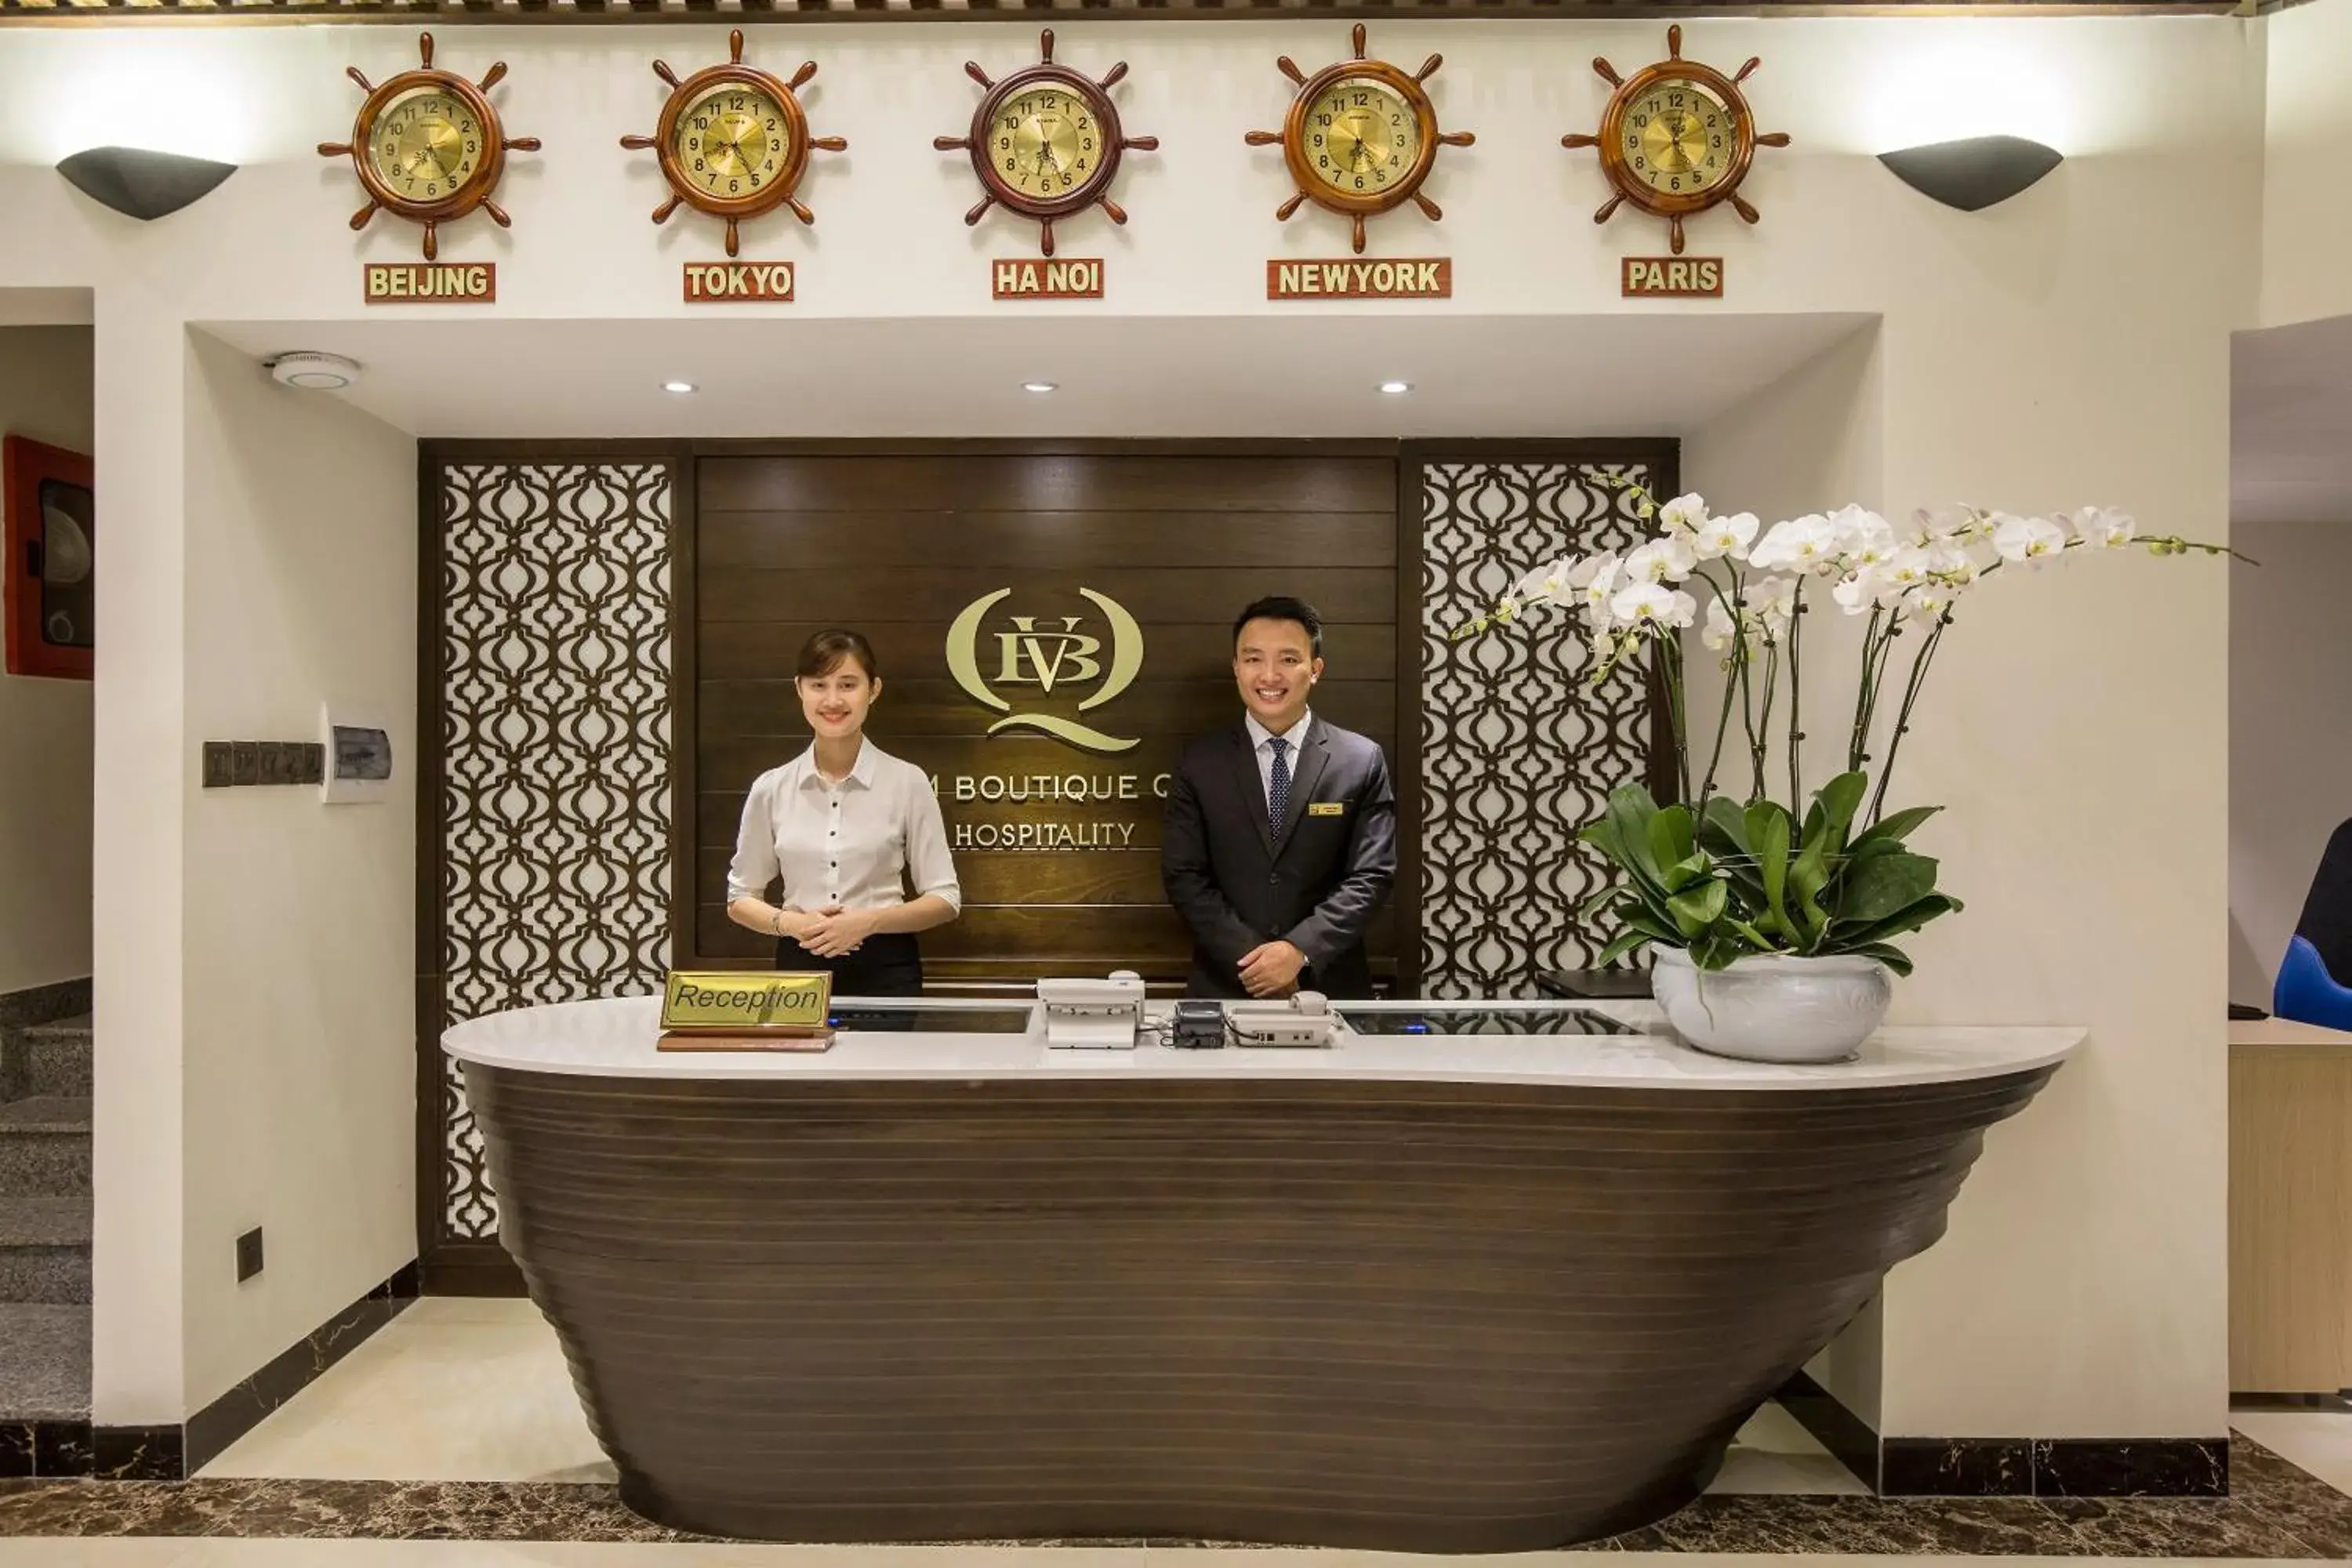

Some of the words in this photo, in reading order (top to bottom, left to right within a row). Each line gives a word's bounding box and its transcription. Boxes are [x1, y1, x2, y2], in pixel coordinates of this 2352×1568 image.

[729, 99, 744, 111] 12
[1039, 97, 1054, 109] 12
[1333, 100, 1345, 111] 11
[1352, 94, 1367, 106] 12
[1377, 99, 1382, 111] 1
[1668, 94, 1683, 107] 12
[1693, 100, 1699, 111] 1
[423, 101, 437, 114] 12
[448, 107, 452, 118] 1
[710, 103, 720, 115] 11
[753, 104, 758, 114] 1
[1019, 102, 1032, 114] 11
[1065, 103, 1069, 114] 1
[1648, 101, 1661, 113] 11
[404, 108, 415, 119] 11
[694, 118, 707, 129] 10
[767, 119, 775, 131] 2
[1004, 118, 1018, 129] 10
[1079, 118, 1087, 129] 2
[1317, 114, 1331, 126] 10
[1392, 114, 1400, 126] 2
[1633, 115, 1646, 127] 10
[1707, 115, 1715, 127] 2
[389, 123, 402, 135] 10
[462, 121, 470, 132] 2
[467, 140, 475, 153] 3
[689, 138, 698, 150] 9
[771, 139, 779, 151] 3
[1001, 138, 1009, 150] 9
[1083, 138, 1091, 151] 3
[1314, 134, 1322, 147] 9
[1396, 134, 1405, 147] 3
[1629, 136, 1638, 147] 9
[1712, 136, 1721, 147] 3
[387, 143, 394, 156] 9
[461, 161, 469, 172] 4
[695, 159, 703, 171] 8
[765, 159, 773, 172] 4
[1007, 158, 1014, 170] 8
[1076, 158, 1085, 170] 4
[1319, 155, 1328, 167] 8
[1390, 155, 1399, 166] 4
[1635, 157, 1643, 169] 8
[1706, 157, 1715, 168] 4
[392, 165, 401, 176] 8
[448, 177, 457, 188] 5
[709, 174, 717, 185] 7
[751, 174, 759, 186] 5
[1021, 173, 1029, 185] 7
[1064, 173, 1072, 185] 5
[1334, 171, 1342, 183] 7
[1355, 176, 1363, 188] 6
[1377, 171, 1385, 183] 5
[1650, 172, 1658, 183] 7
[1693, 171, 1701, 183] 5
[406, 179, 414, 190] 7
[427, 183, 436, 195] 6
[729, 180, 738, 192] 6
[1042, 179, 1050, 191] 6
[1671, 177, 1679, 190] 6
[369, 268, 487, 296] BEIJING
[687, 267, 791, 296] TOKYO
[997, 264, 1040, 292] HA
[1047, 263, 1098, 292] NOI
[1279, 263, 1440, 292] NEWYORK
[1628, 262, 1718, 290] PARIS
[956, 775, 1138, 801] BOUTIQUE
[956, 823, 1134, 846] HOSPITALITY
[675, 985, 818, 1013] Reception
